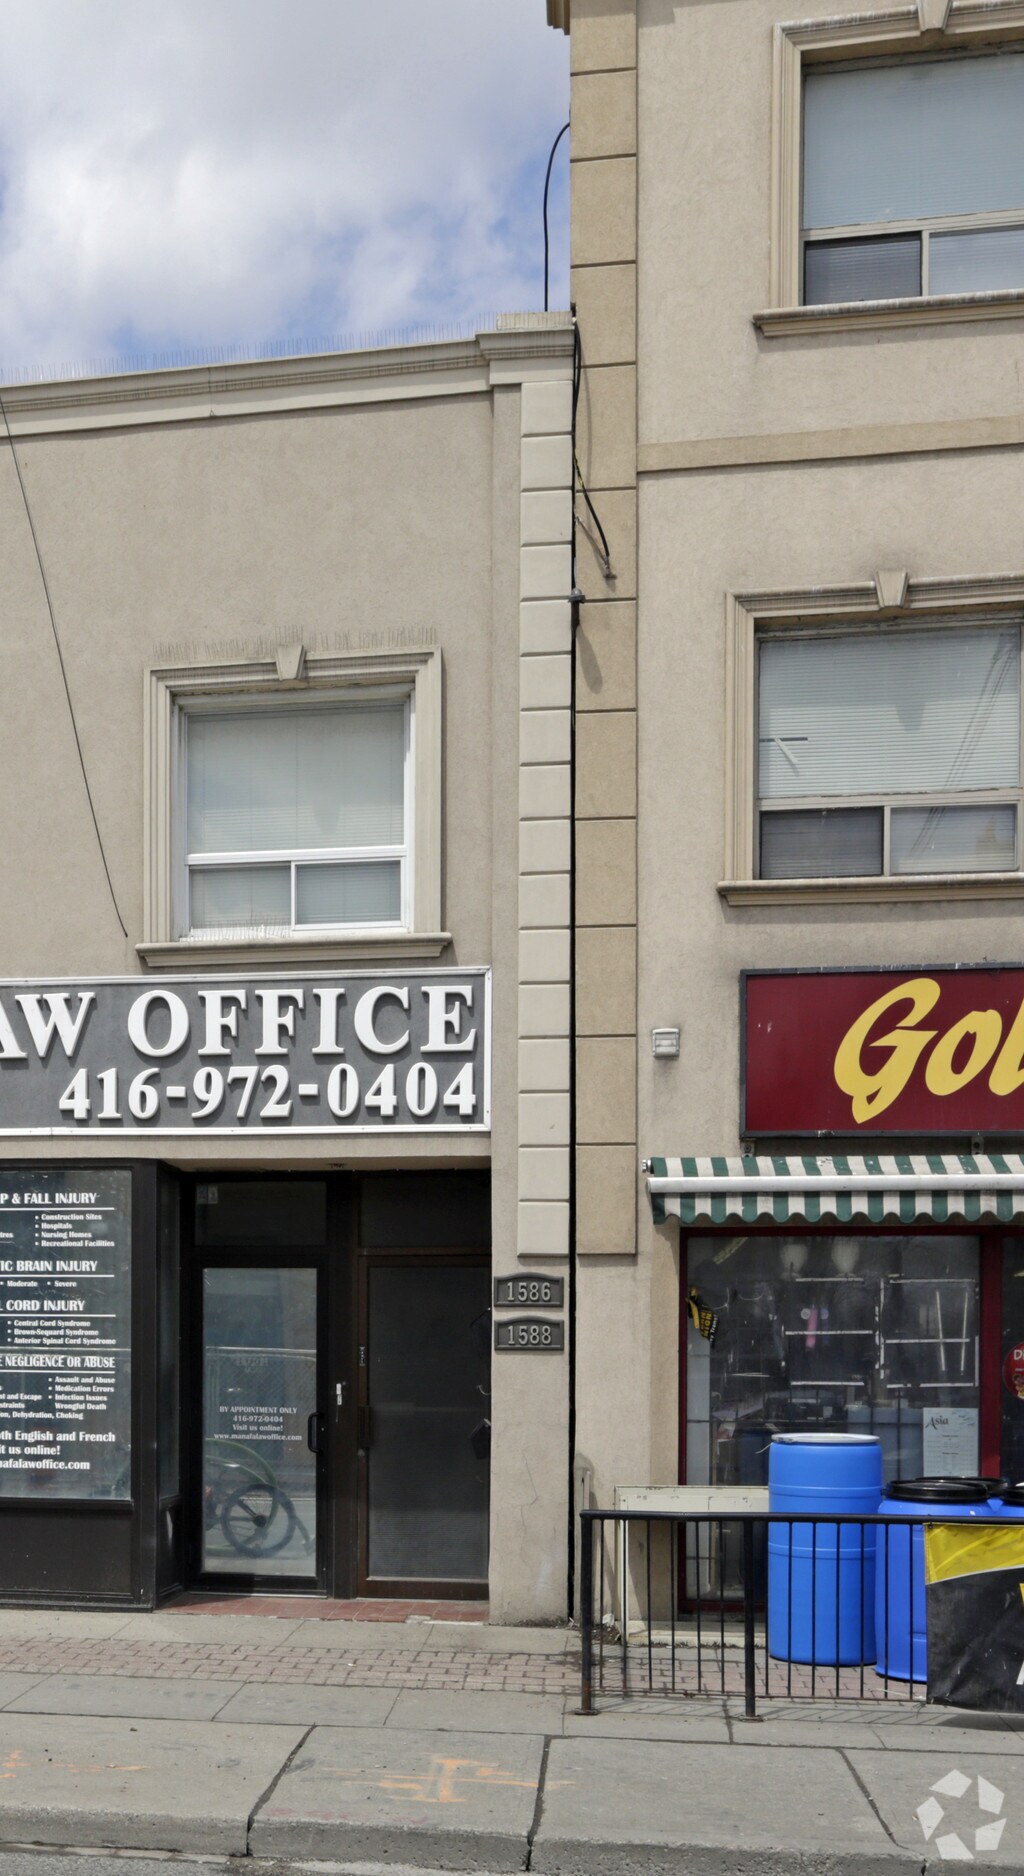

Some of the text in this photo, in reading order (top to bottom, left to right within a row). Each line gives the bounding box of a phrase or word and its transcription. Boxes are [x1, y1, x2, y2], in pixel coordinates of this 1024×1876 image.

[127, 985, 477, 1058] OFFICE
[58, 1062, 477, 1120] 416-972-0404
[11, 1193, 21, 1204] &
[24, 1193, 52, 1204] FALL
[55, 1193, 97, 1204] INJURY
[41, 1222, 73, 1230] Hospitals
[41, 1231, 68, 1239] Nursing
[41, 1239, 84, 1247] Recreational
[16, 1260, 52, 1271] BRAIN
[56, 1260, 98, 1271] INJURY
[507, 1282, 551, 1301] 1586
[6, 1300, 40, 1311] CORD
[44, 1300, 85, 1311] INJURY
[507, 1325, 552, 1345] 1588
[5, 1355, 65, 1367] NEGLIGENCE
[67, 1356, 81, 1367] OR
[82, 1356, 115, 1368] ABUSE
[55, 1403, 86, 1411] Wrongful
[925, 1415, 949, 1430] Asia
[15, 1430, 53, 1443] English
[56, 1431, 76, 1441] and
[79, 1431, 116, 1442] French
[8, 1446, 21, 1454] us
[24, 1445, 60, 1455] online!
